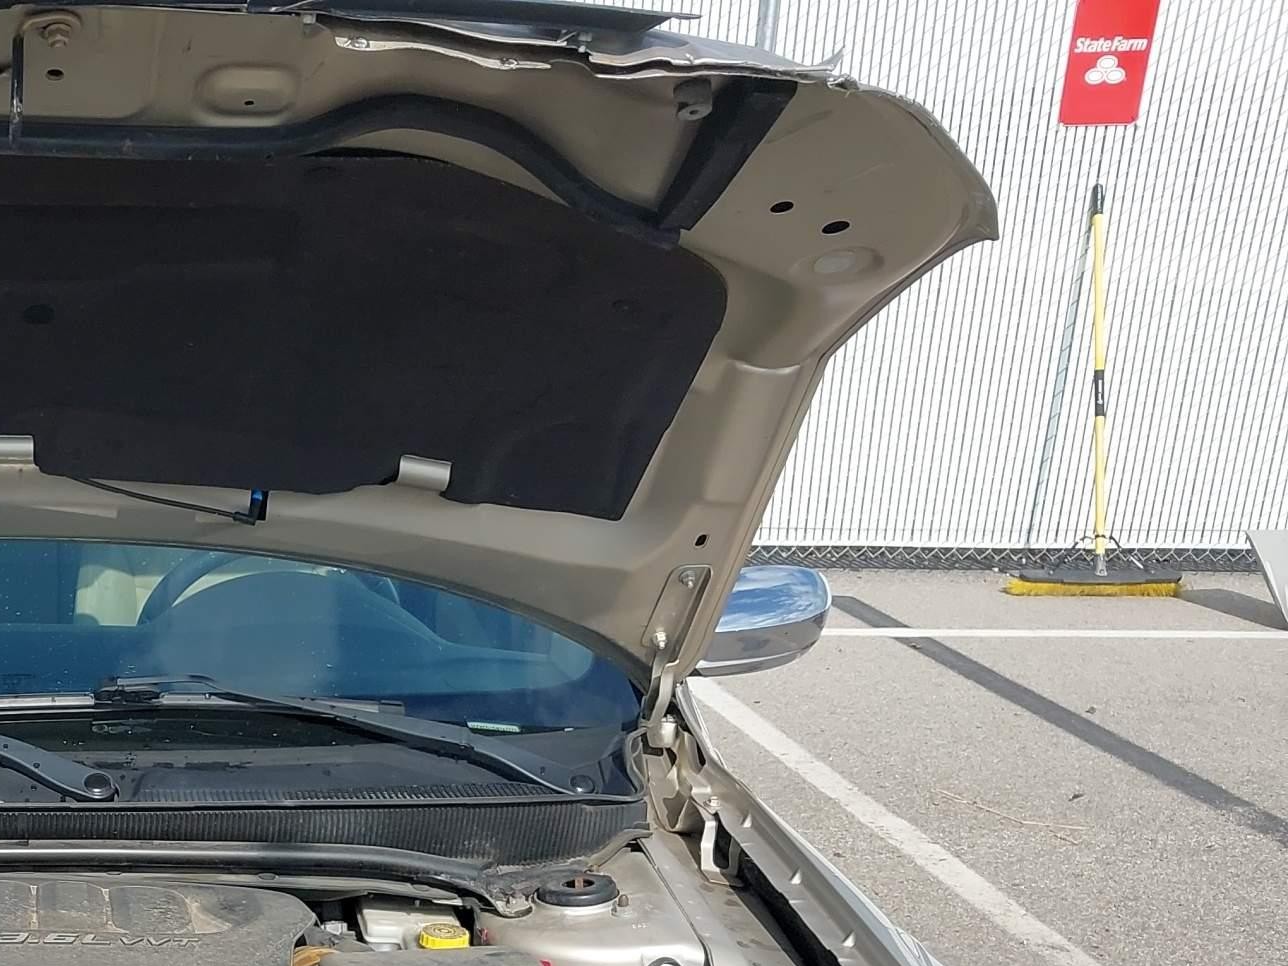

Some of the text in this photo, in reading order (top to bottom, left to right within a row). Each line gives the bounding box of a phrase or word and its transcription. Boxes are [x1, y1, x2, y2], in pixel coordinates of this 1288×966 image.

[1074, 36, 1148, 53] State Farm
[119, 936, 200, 947] VVT
